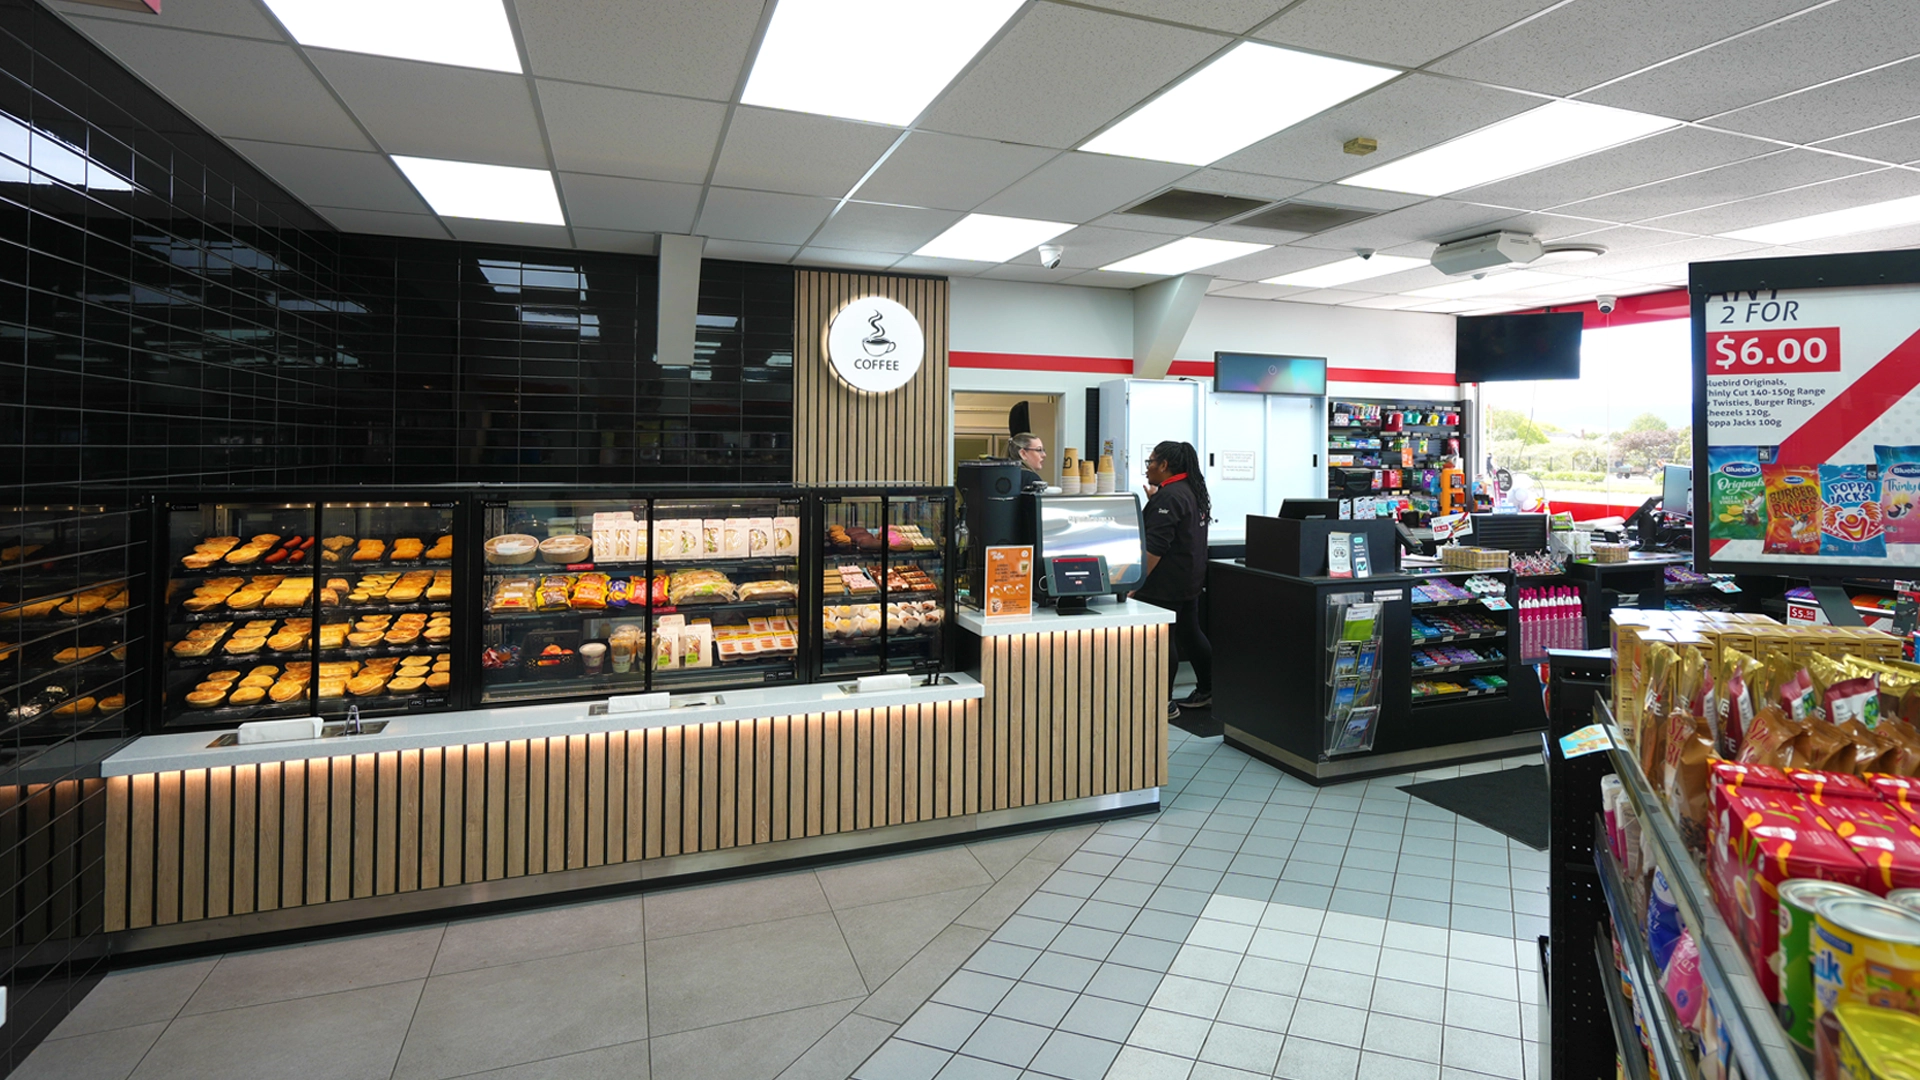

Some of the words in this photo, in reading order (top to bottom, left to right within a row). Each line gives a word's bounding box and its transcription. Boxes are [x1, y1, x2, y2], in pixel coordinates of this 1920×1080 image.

[1720, 305, 1735, 325] 2
[1745, 300, 1799, 323] FOR
[1715, 334, 1828, 370] $6.00
[853, 358, 900, 371] COFFEE
[1742, 378, 1787, 388] Originals,
[1732, 388, 1748, 397] Cut
[1750, 387, 1795, 397] 140-150g
[1797, 387, 1826, 397] Range
[1712, 399, 1752, 407] Twisties,
[1754, 398, 1784, 408] Burger
[1786, 397, 1815, 407] Rings,
[1707, 409, 1743, 417] heezels
[1745, 408, 1771, 418] 120g,
[1732, 418, 1757, 427] Jacks
[1759, 418, 1782, 428] 100g
[1717, 477, 1765, 494] Originals
[1829, 482, 1874, 494] POPPA
[1885, 479, 1916, 494] Thinly
[1769, 485, 1817, 503] BURGER
[1830, 492, 1870, 504] JACKS
[1771, 497, 1820, 517] RINGS
